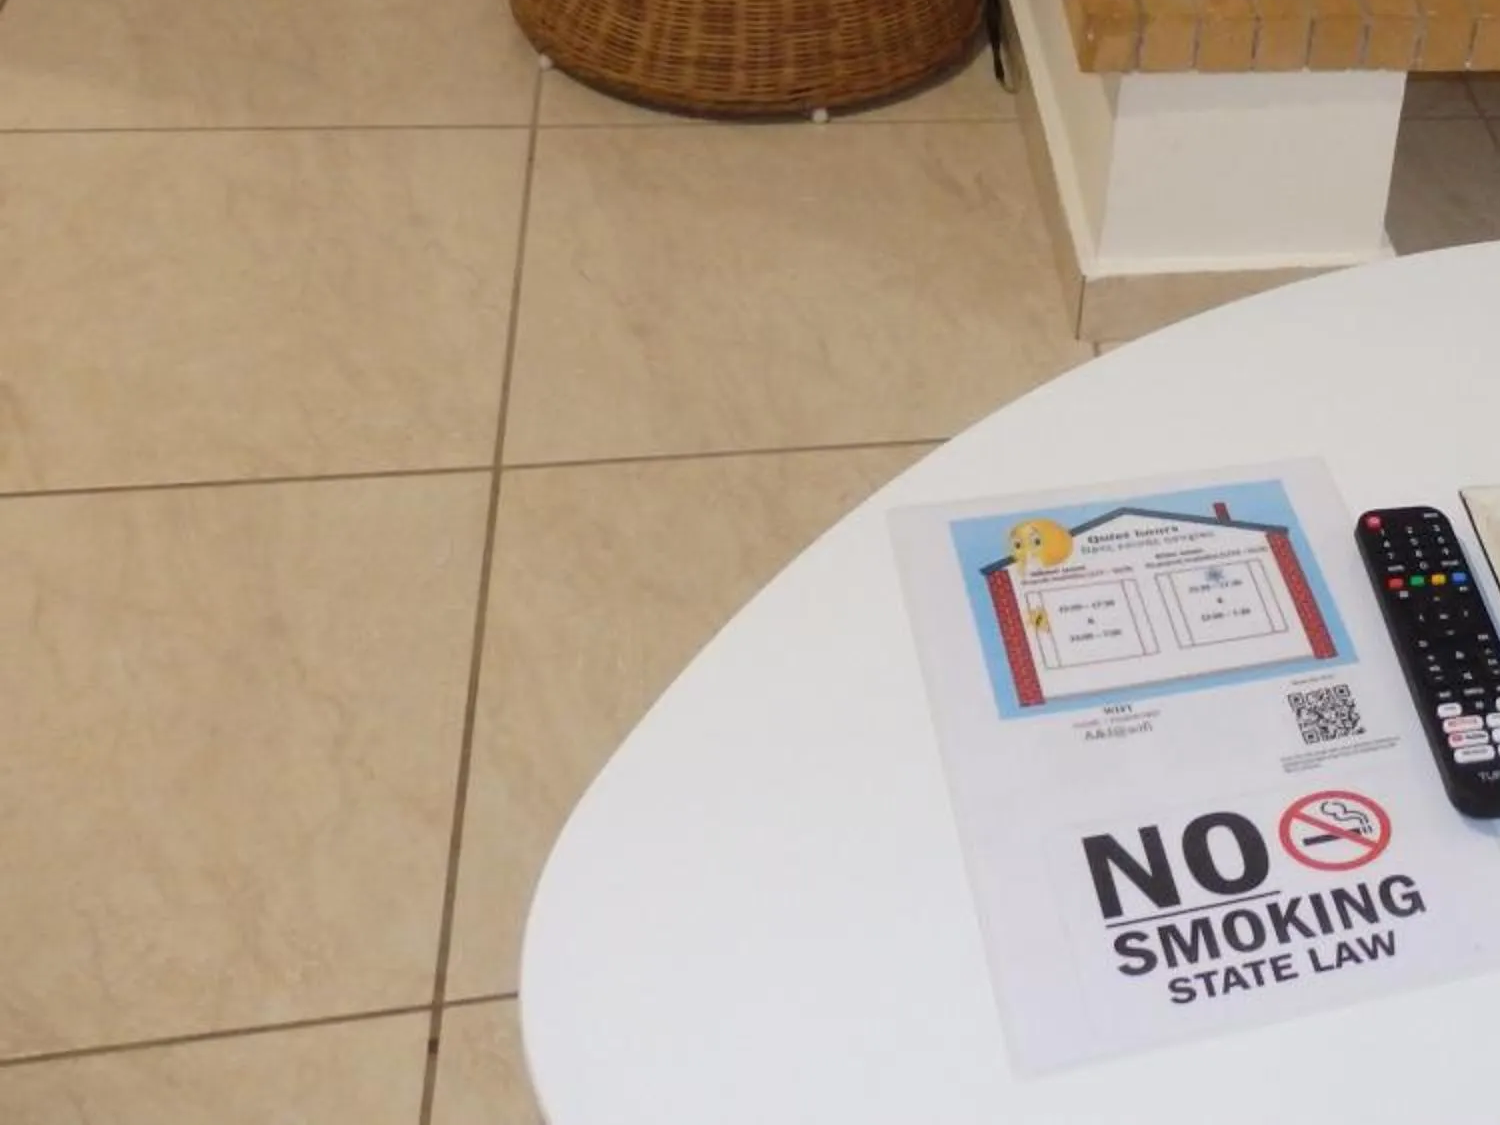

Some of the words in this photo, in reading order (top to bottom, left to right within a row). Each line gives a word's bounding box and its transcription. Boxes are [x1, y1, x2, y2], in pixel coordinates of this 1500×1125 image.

[1082, 811, 1270, 919] NO
[1113, 874, 1426, 976] SMOKING
[1167, 953, 1298, 1005] STATE
[1307, 930, 1397, 972] LAW
